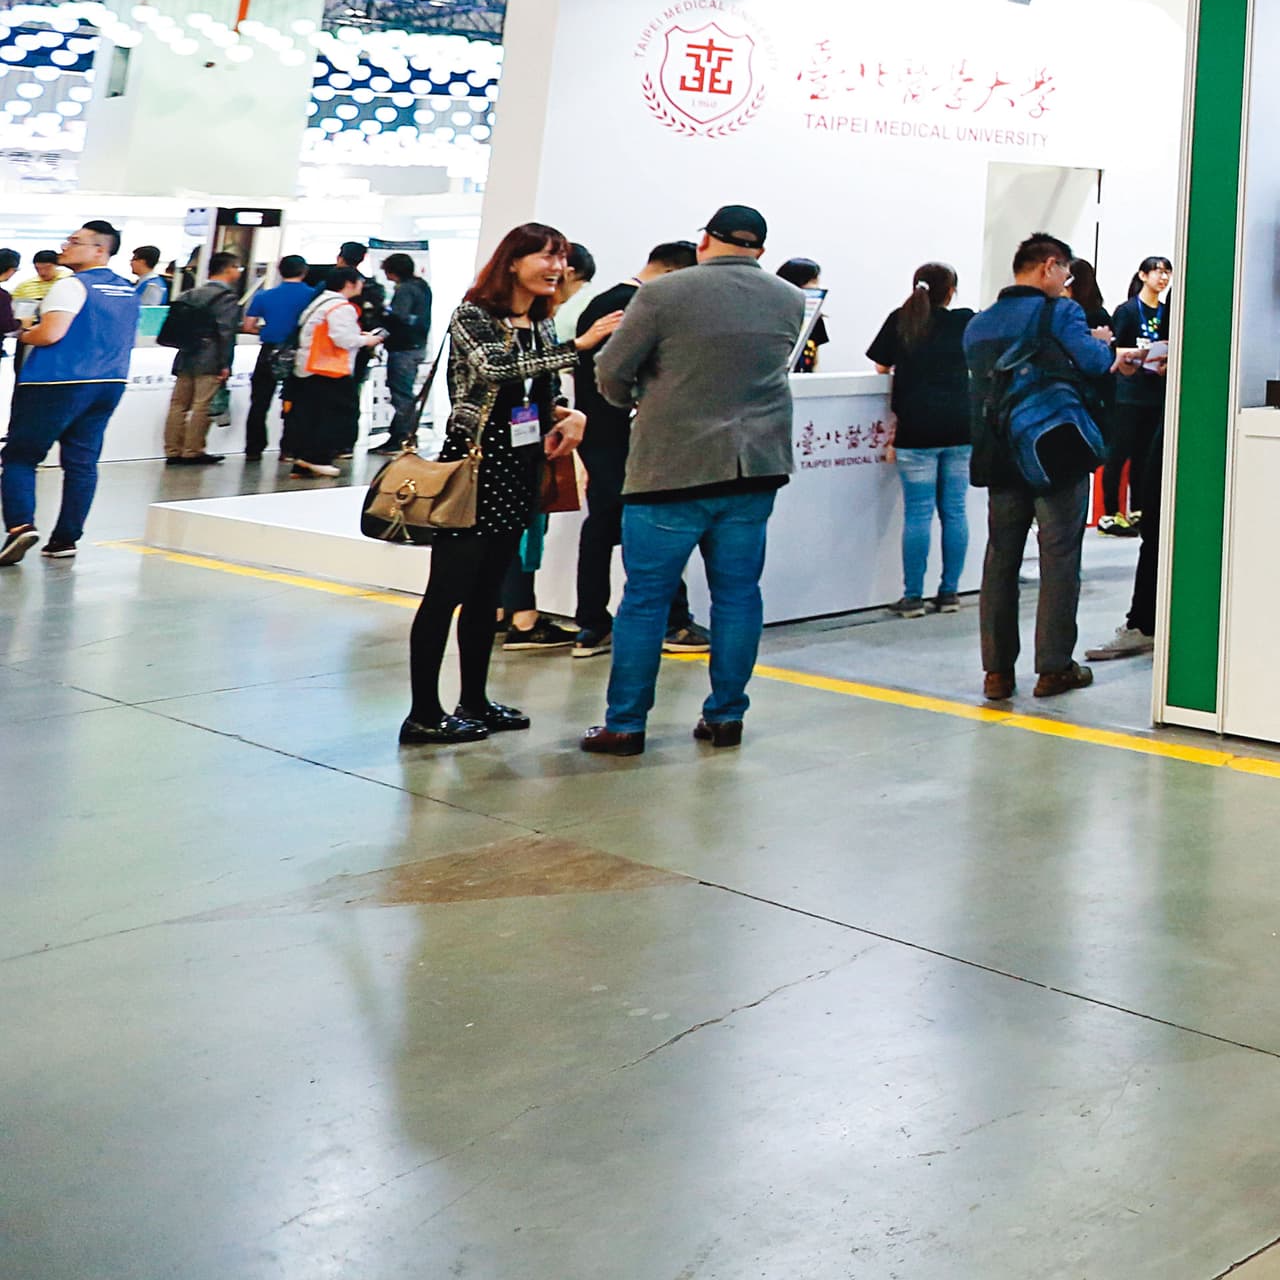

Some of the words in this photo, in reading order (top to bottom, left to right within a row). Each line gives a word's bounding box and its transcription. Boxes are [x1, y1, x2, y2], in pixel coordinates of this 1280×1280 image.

[803, 113, 868, 132] TAIPEI
[874, 119, 950, 140] MEDICAL
[956, 126, 1048, 147] UNIVERSITY
